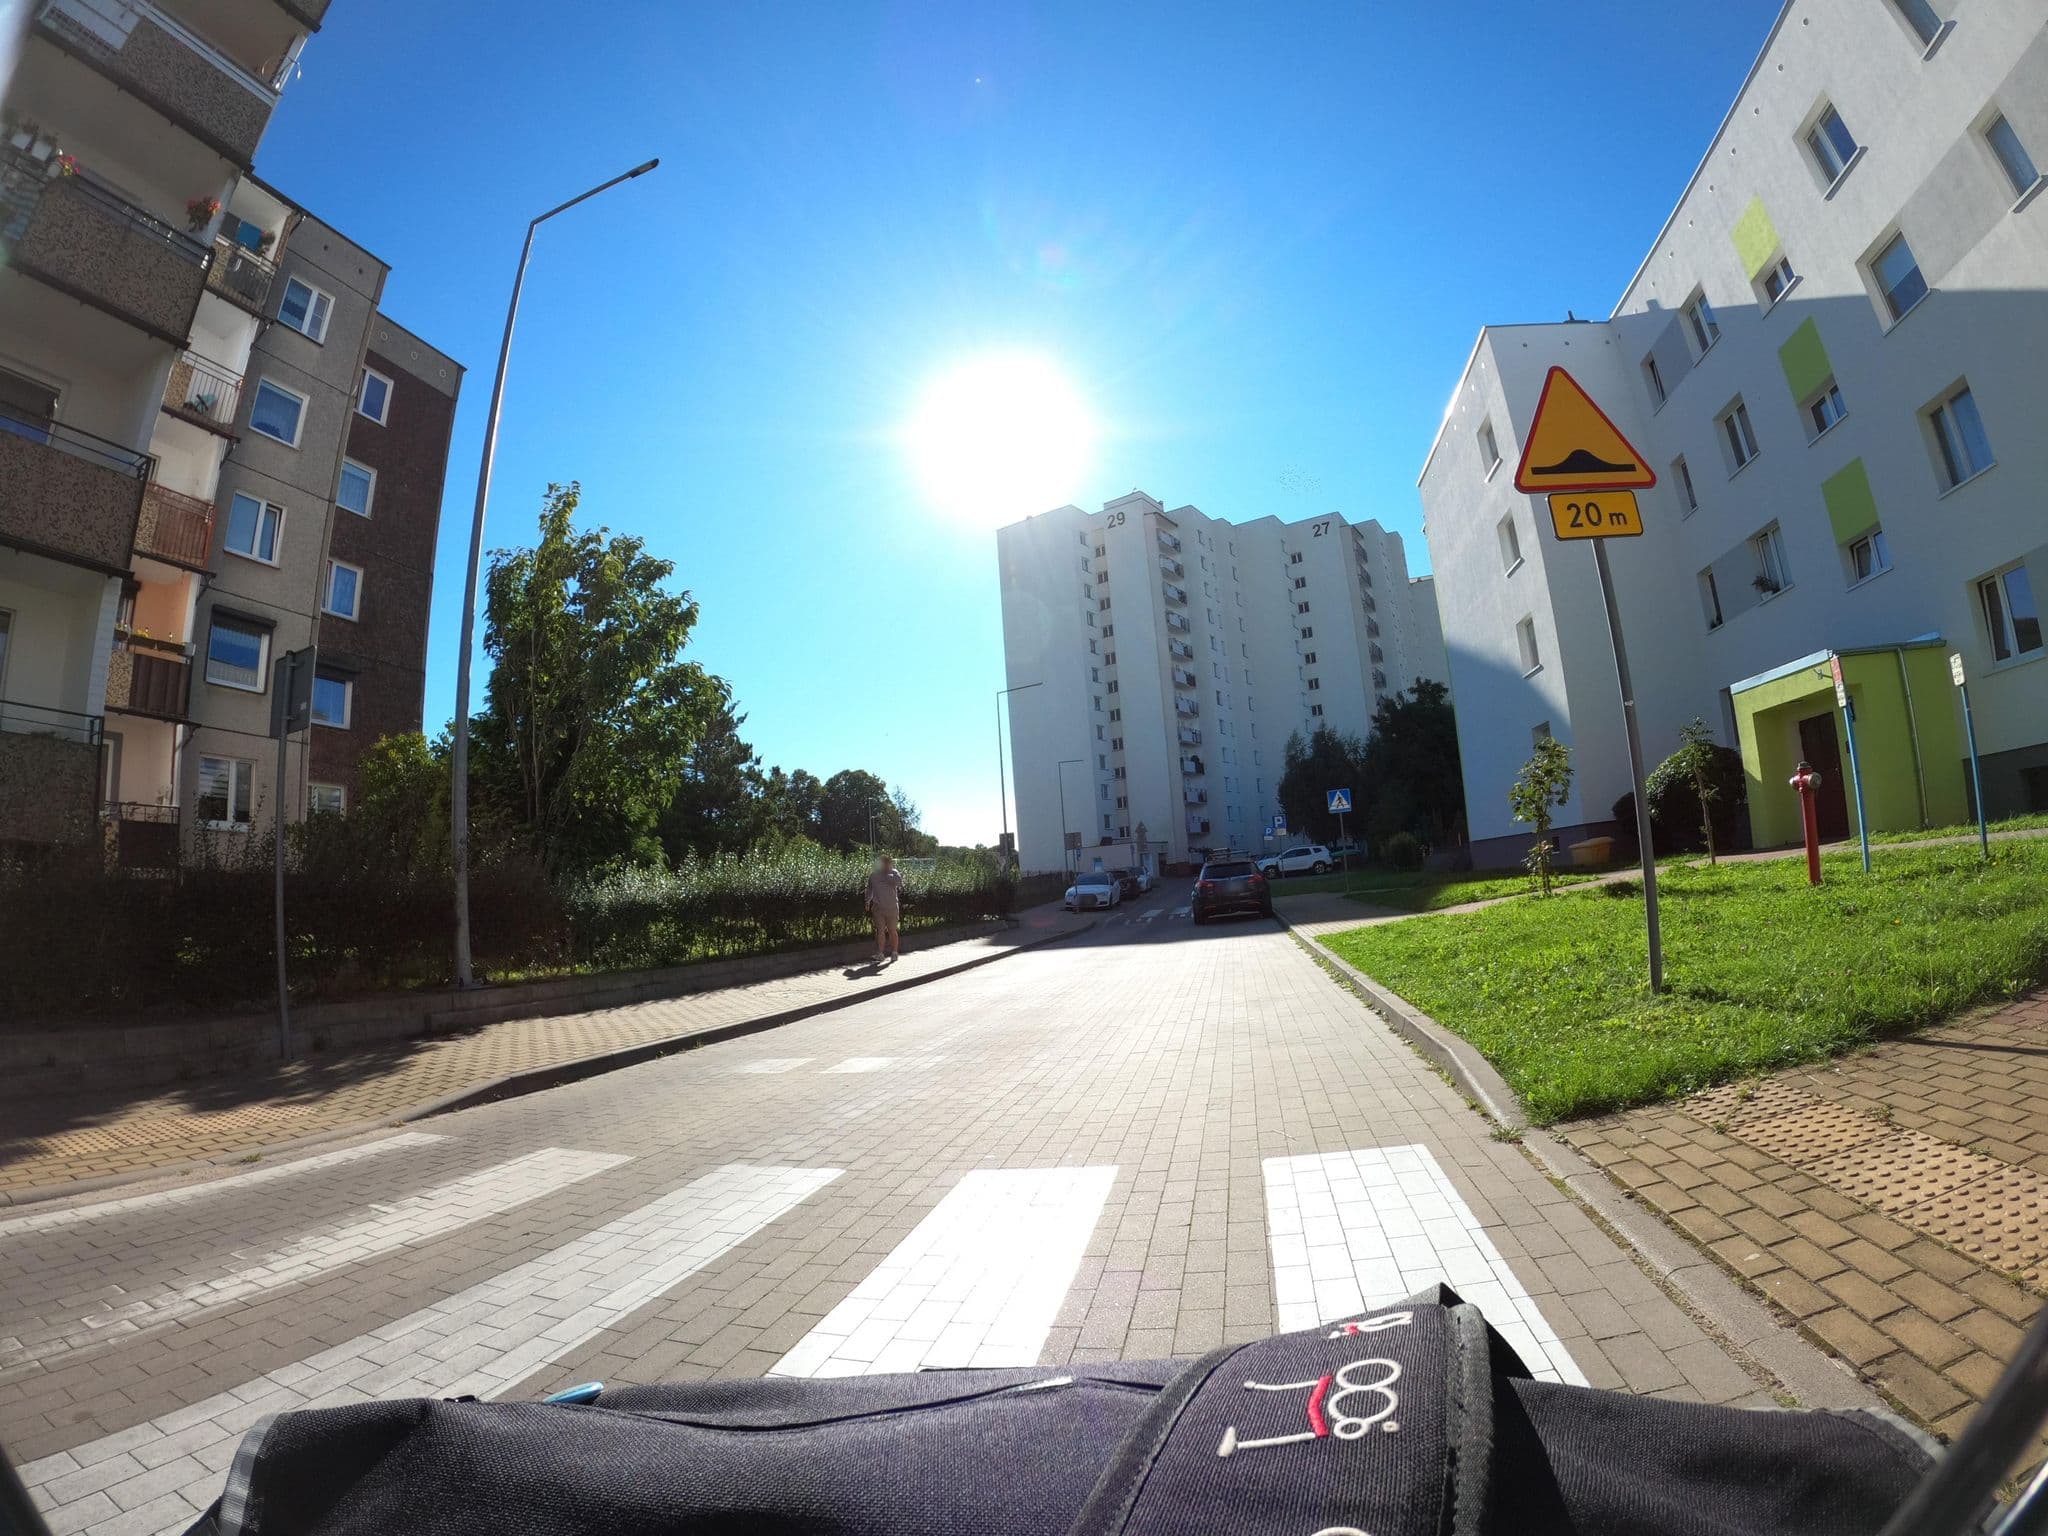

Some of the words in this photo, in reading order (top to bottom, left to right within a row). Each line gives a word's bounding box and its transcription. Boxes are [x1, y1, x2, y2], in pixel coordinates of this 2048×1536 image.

[1107, 511, 1126, 529] 29
[1566, 502, 1603, 528] 20
[1608, 512, 1628, 526] m
[1312, 521, 1330, 538] 27
[1274, 816, 1283, 828] P
